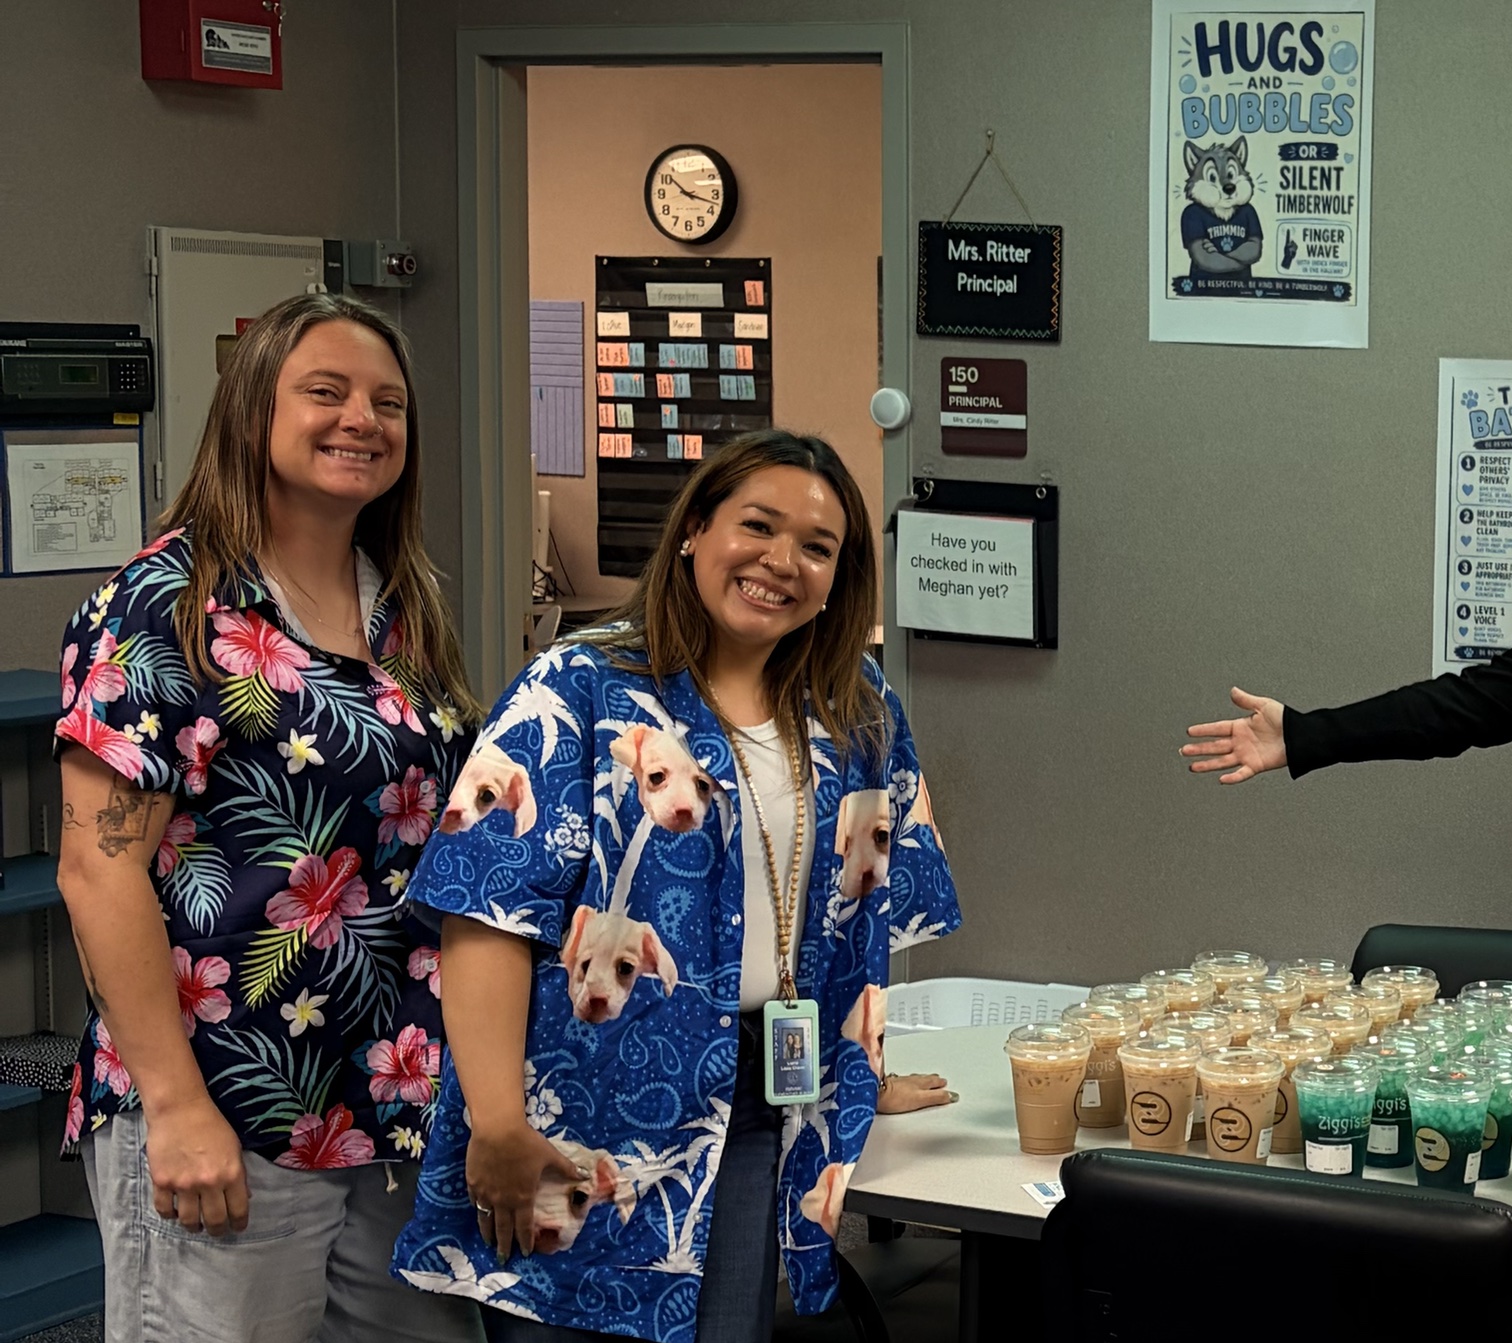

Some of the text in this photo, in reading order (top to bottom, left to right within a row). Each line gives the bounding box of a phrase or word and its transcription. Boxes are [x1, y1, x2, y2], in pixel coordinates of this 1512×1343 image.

[1194, 20, 1325, 78] HUGS
[1247, 76, 1283, 90] AND
[1181, 91, 1355, 139] BUBBLES
[1299, 145, 1318, 158] OR
[660, 174, 672, 185] 10
[1279, 165, 1344, 191] SILENT
[657, 188, 666, 199] 9
[711, 189, 719, 200] 3
[662, 204, 670, 215] 8
[1275, 193, 1354, 215] TIMBERWOLF
[706, 205, 714, 216] 4
[671, 216, 679, 227] 7
[684, 220, 693, 231] 6
[696, 216, 705, 227] 5
[1207, 224, 1246, 239] THIMMIG
[1302, 228, 1345, 243] FINGER
[947, 238, 1031, 263] Mrs. Ritter
[1306, 244, 1340, 258] WAVE
[957, 272, 1017, 297] Principal
[949, 366, 979, 383] 150
[948, 395, 1003, 408] PRINCIPAL
[1465, 458, 1471, 469] 1
[1479, 456, 1512, 465] RESPECT
[1479, 476, 1510, 485] PRIVACY
[1463, 511, 1470, 522] 2
[1476, 510, 1512, 519] HELP KEEP
[1476, 528, 1499, 536] CLEAN
[931, 532, 996, 553] Have you
[910, 554, 1017, 576] checked in with
[1462, 562, 1468, 573] 3
[1475, 562, 1494, 570] JUST
[1495, 562, 1508, 570] USE
[918, 576, 1009, 600] Meghan yet?
[1460, 607, 1466, 617] 4
[1474, 605, 1498, 615] LEVEL
[1474, 616, 1497, 625] VOICE
[1086, 1059, 1116, 1076] ggi's
[1318, 1115, 1361, 1135] Ziggi's
